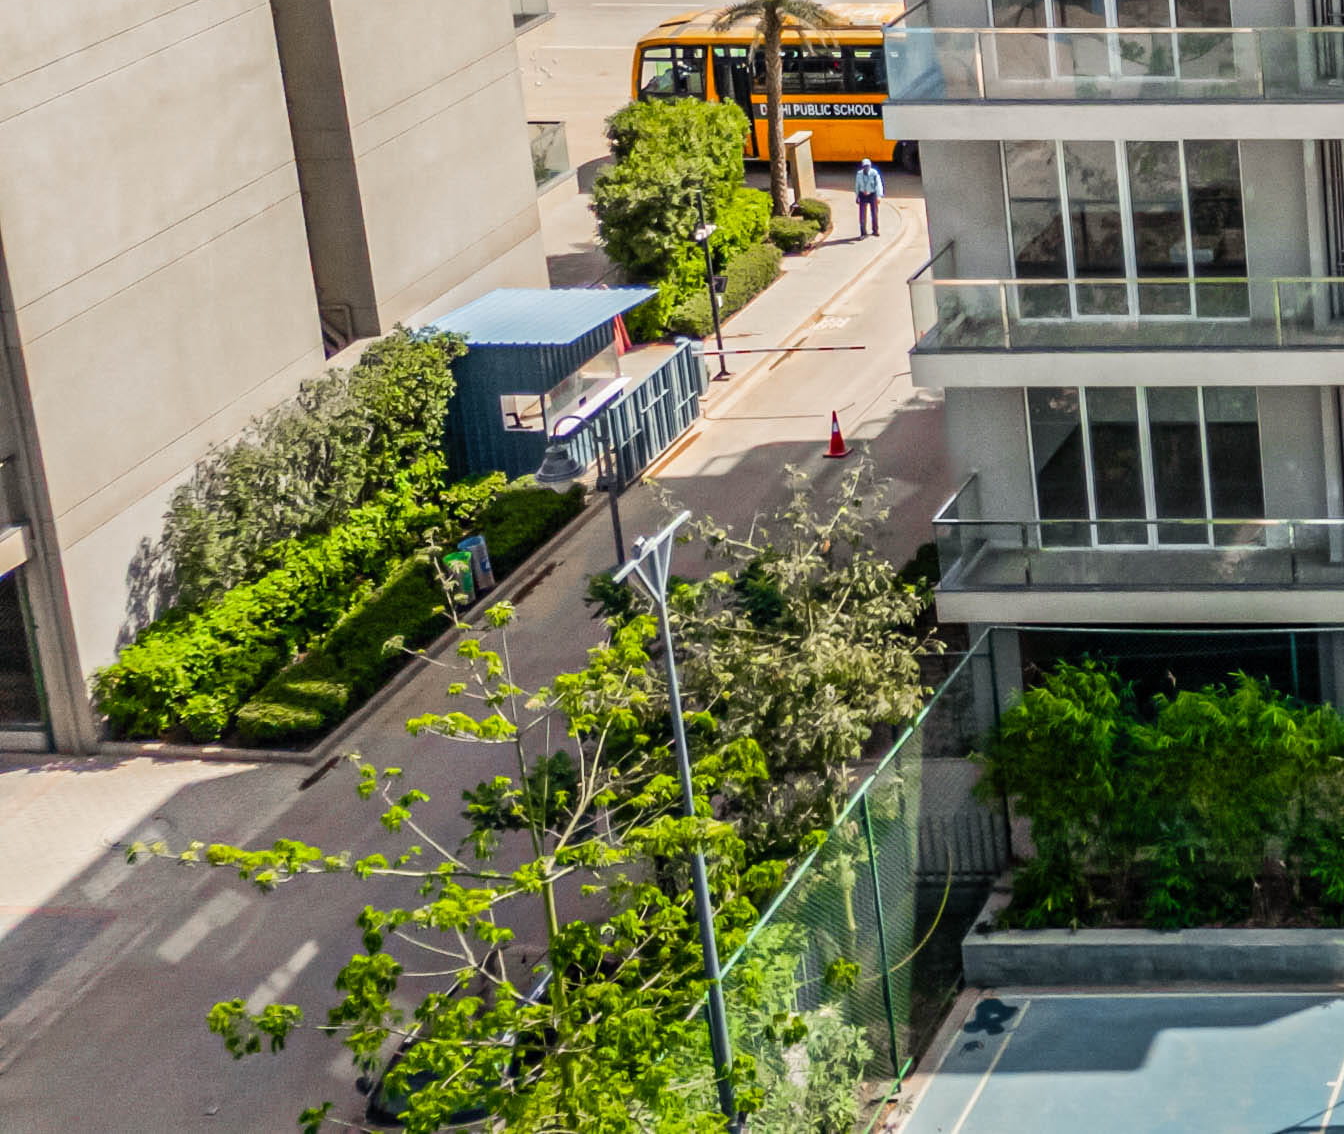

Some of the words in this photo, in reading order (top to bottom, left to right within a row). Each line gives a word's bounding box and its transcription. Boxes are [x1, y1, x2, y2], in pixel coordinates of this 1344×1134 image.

[760, 104, 791, 116] DHI
[793, 104, 832, 116] PUBLIC
[833, 104, 878, 116] SCHOOL
